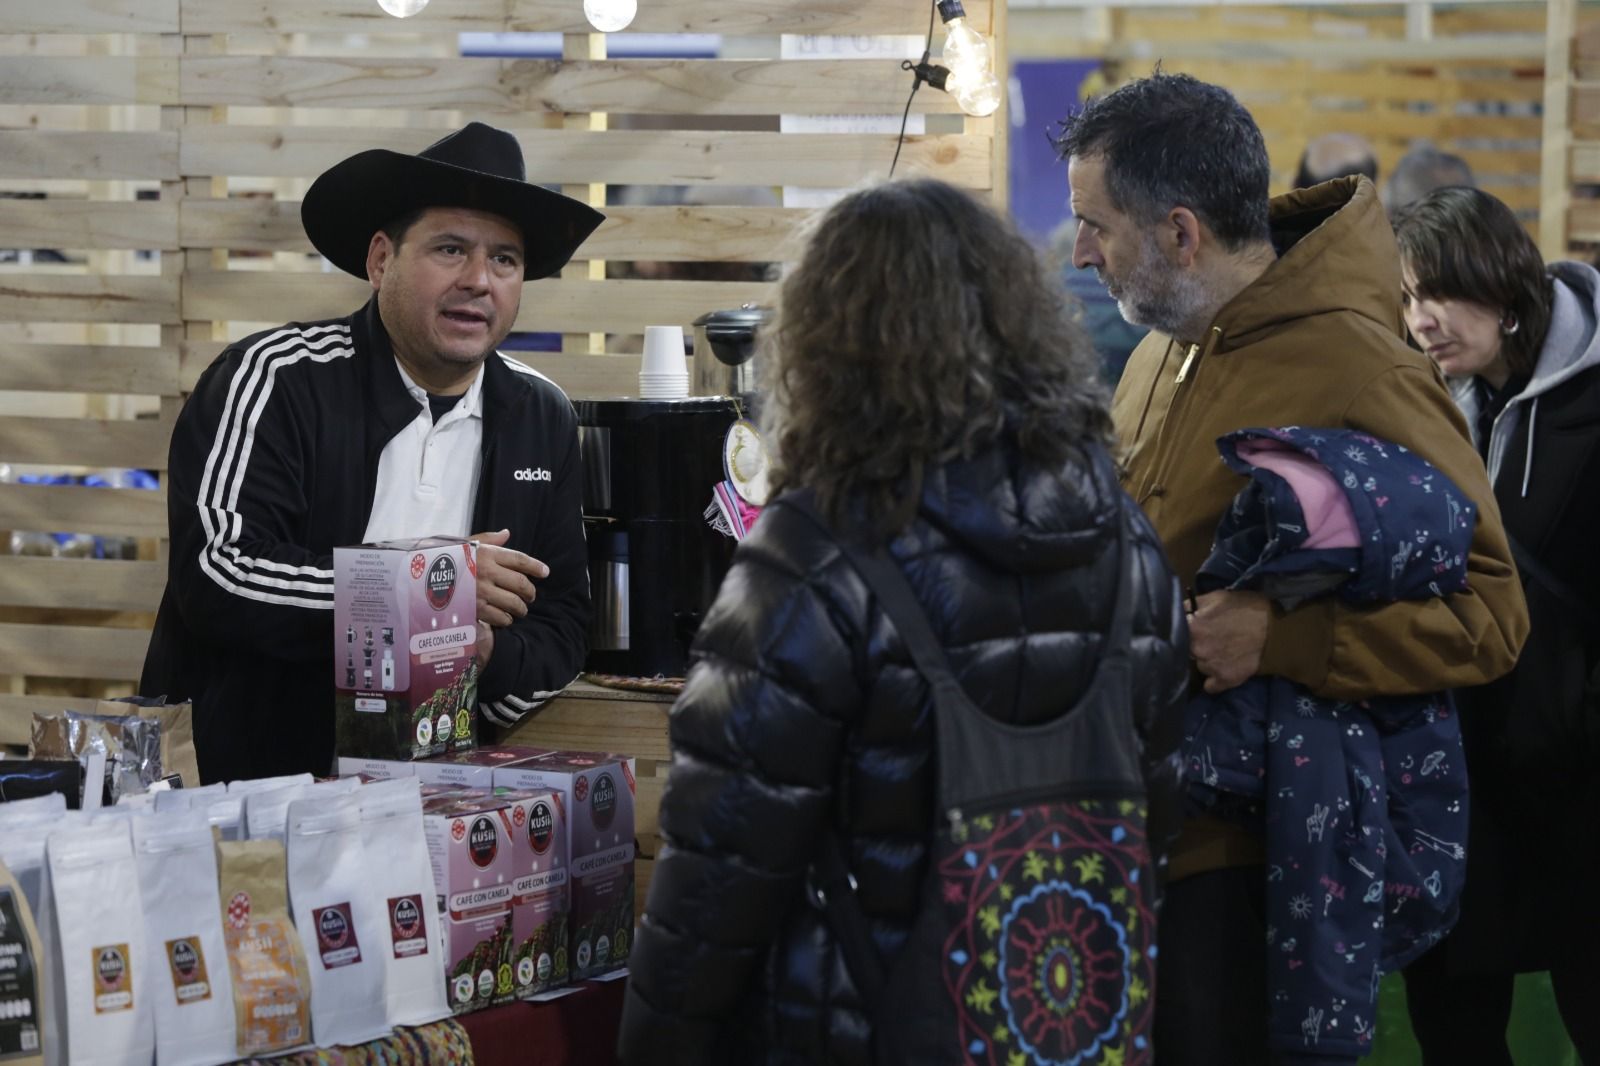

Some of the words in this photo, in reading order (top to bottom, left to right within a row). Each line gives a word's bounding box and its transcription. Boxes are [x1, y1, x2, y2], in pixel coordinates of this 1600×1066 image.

[418, 635, 432, 648] CAFÉ
[433, 635, 445, 646] CON
[445, 631, 467, 645] CANELA
[580, 861, 595, 873] CAFÉ
[595, 858, 608, 869] CON
[607, 851, 626, 866] CANELA
[517, 879, 532, 891] CAFÉ
[532, 877, 545, 889] CON
[545, 872, 565, 886] CANELA
[456, 894, 473, 906] CAFÉ
[474, 892, 487, 904] CON
[487, 888, 510, 902] CANELA
